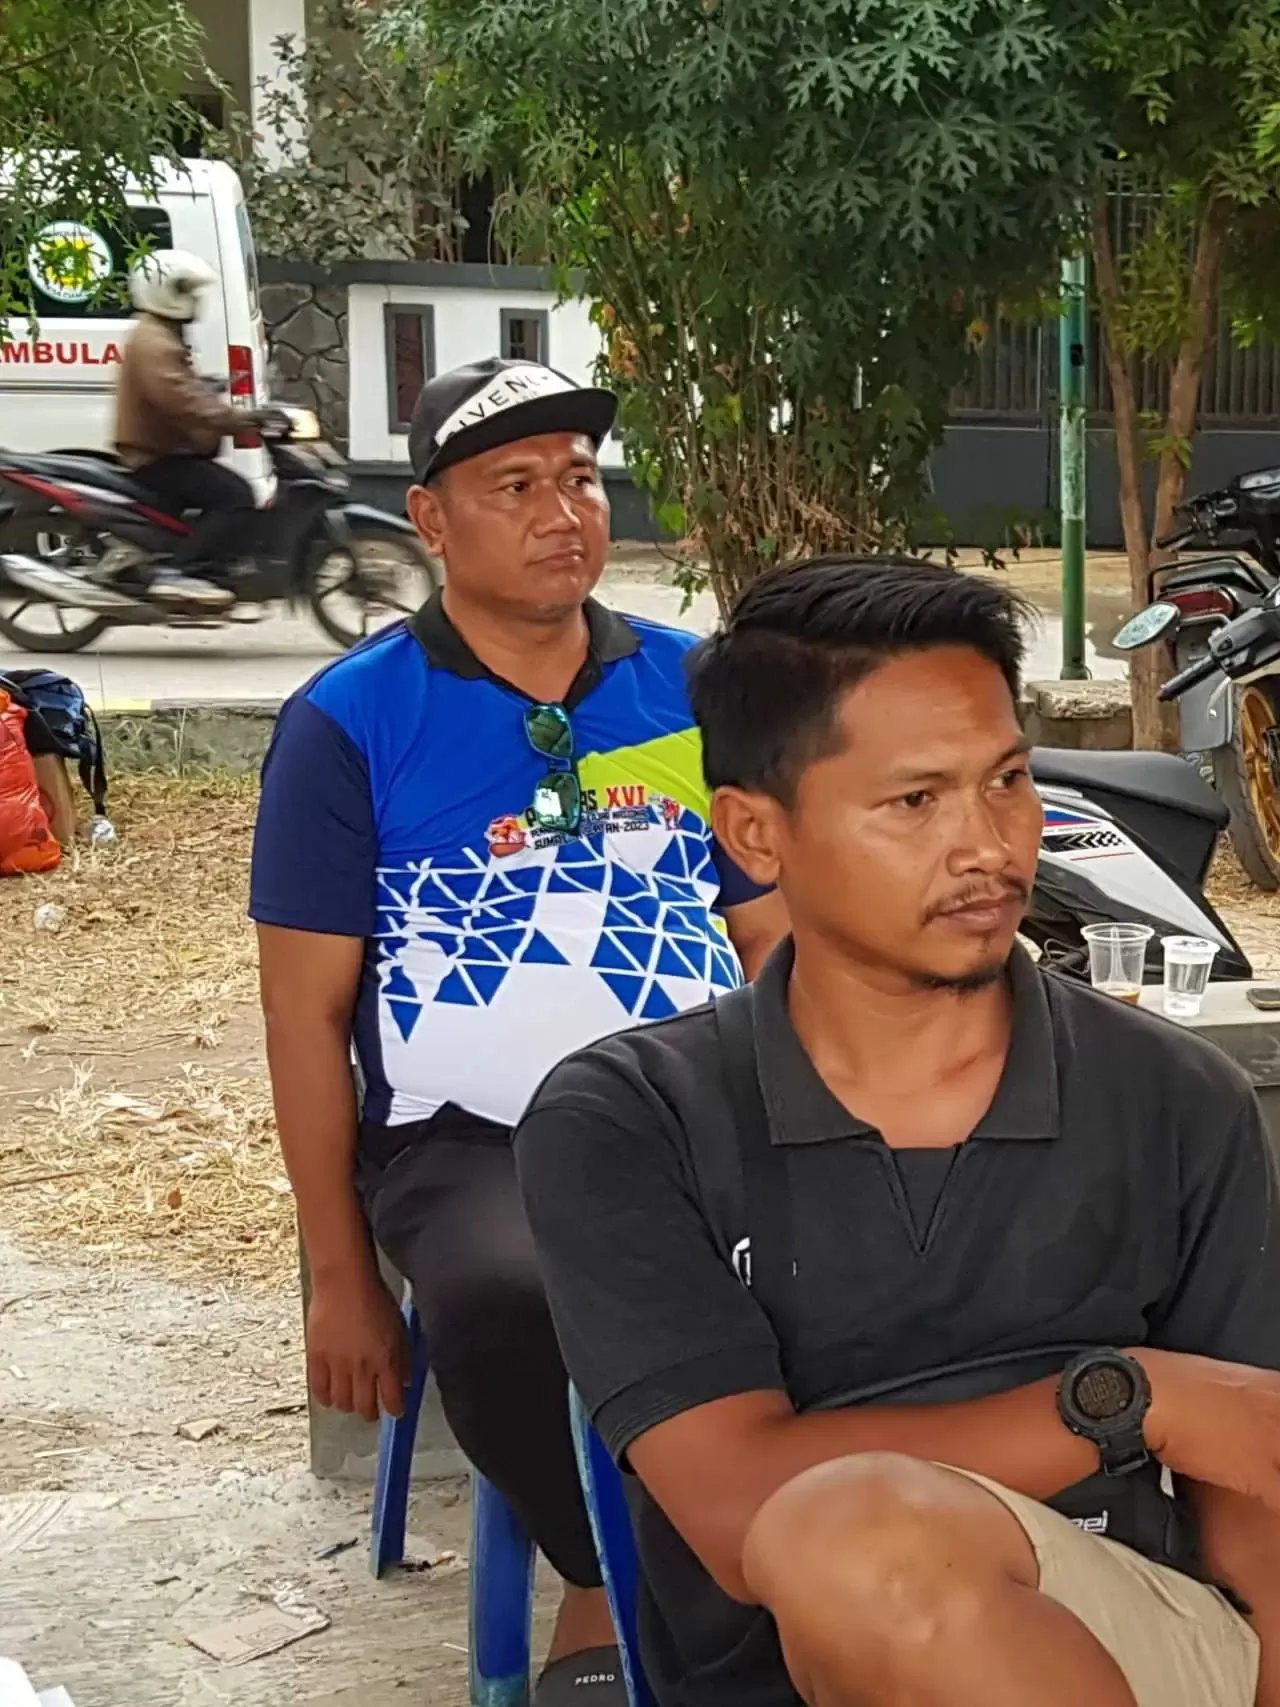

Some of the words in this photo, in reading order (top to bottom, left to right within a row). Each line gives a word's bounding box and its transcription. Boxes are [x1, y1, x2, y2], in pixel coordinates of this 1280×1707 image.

[0, 341, 125, 365] MBULA
[606, 784, 646, 808] XVI
[575, 1674, 615, 1685] PEDRO
